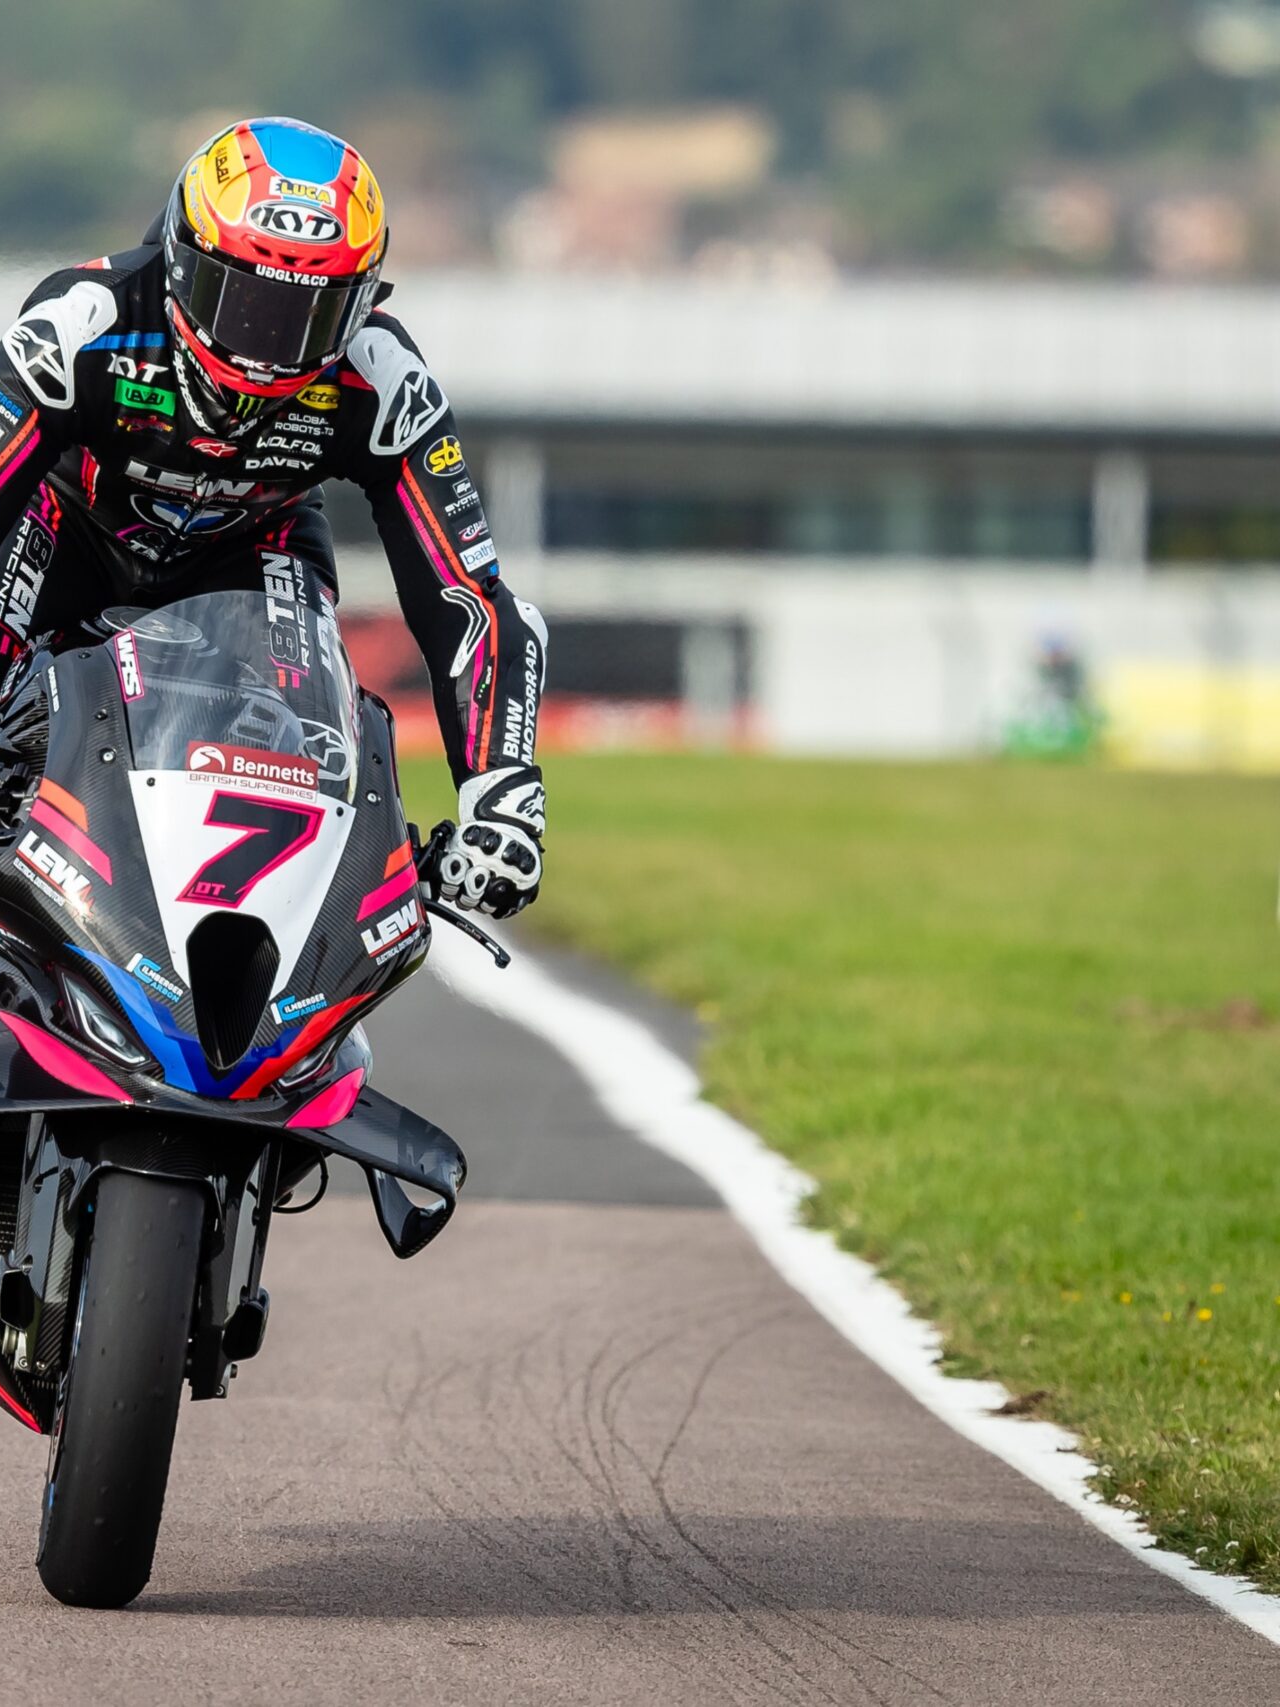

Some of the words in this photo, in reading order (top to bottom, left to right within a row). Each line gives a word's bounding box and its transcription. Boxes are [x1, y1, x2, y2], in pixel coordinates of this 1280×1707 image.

[280, 181, 332, 205] LUCA
[260, 206, 337, 237] KYT
[275, 422, 321, 436] ROBOTS
[288, 413, 329, 425] GLOBA
[256, 437, 303, 449] WOLF
[125, 460, 255, 497] LEW
[245, 456, 315, 471] DAVEY
[293, 558, 311, 669] RACING
[521, 639, 538, 767] MOTORRAD
[502, 698, 524, 760] BMW
[232, 755, 315, 786] Bennetts
[189, 773, 238, 786] BRITISH
[240, 781, 314, 801] SUPERBIKES
[18, 830, 90, 895] LEW
[175, 790, 326, 909] 7
[360, 899, 418, 955] LEW
